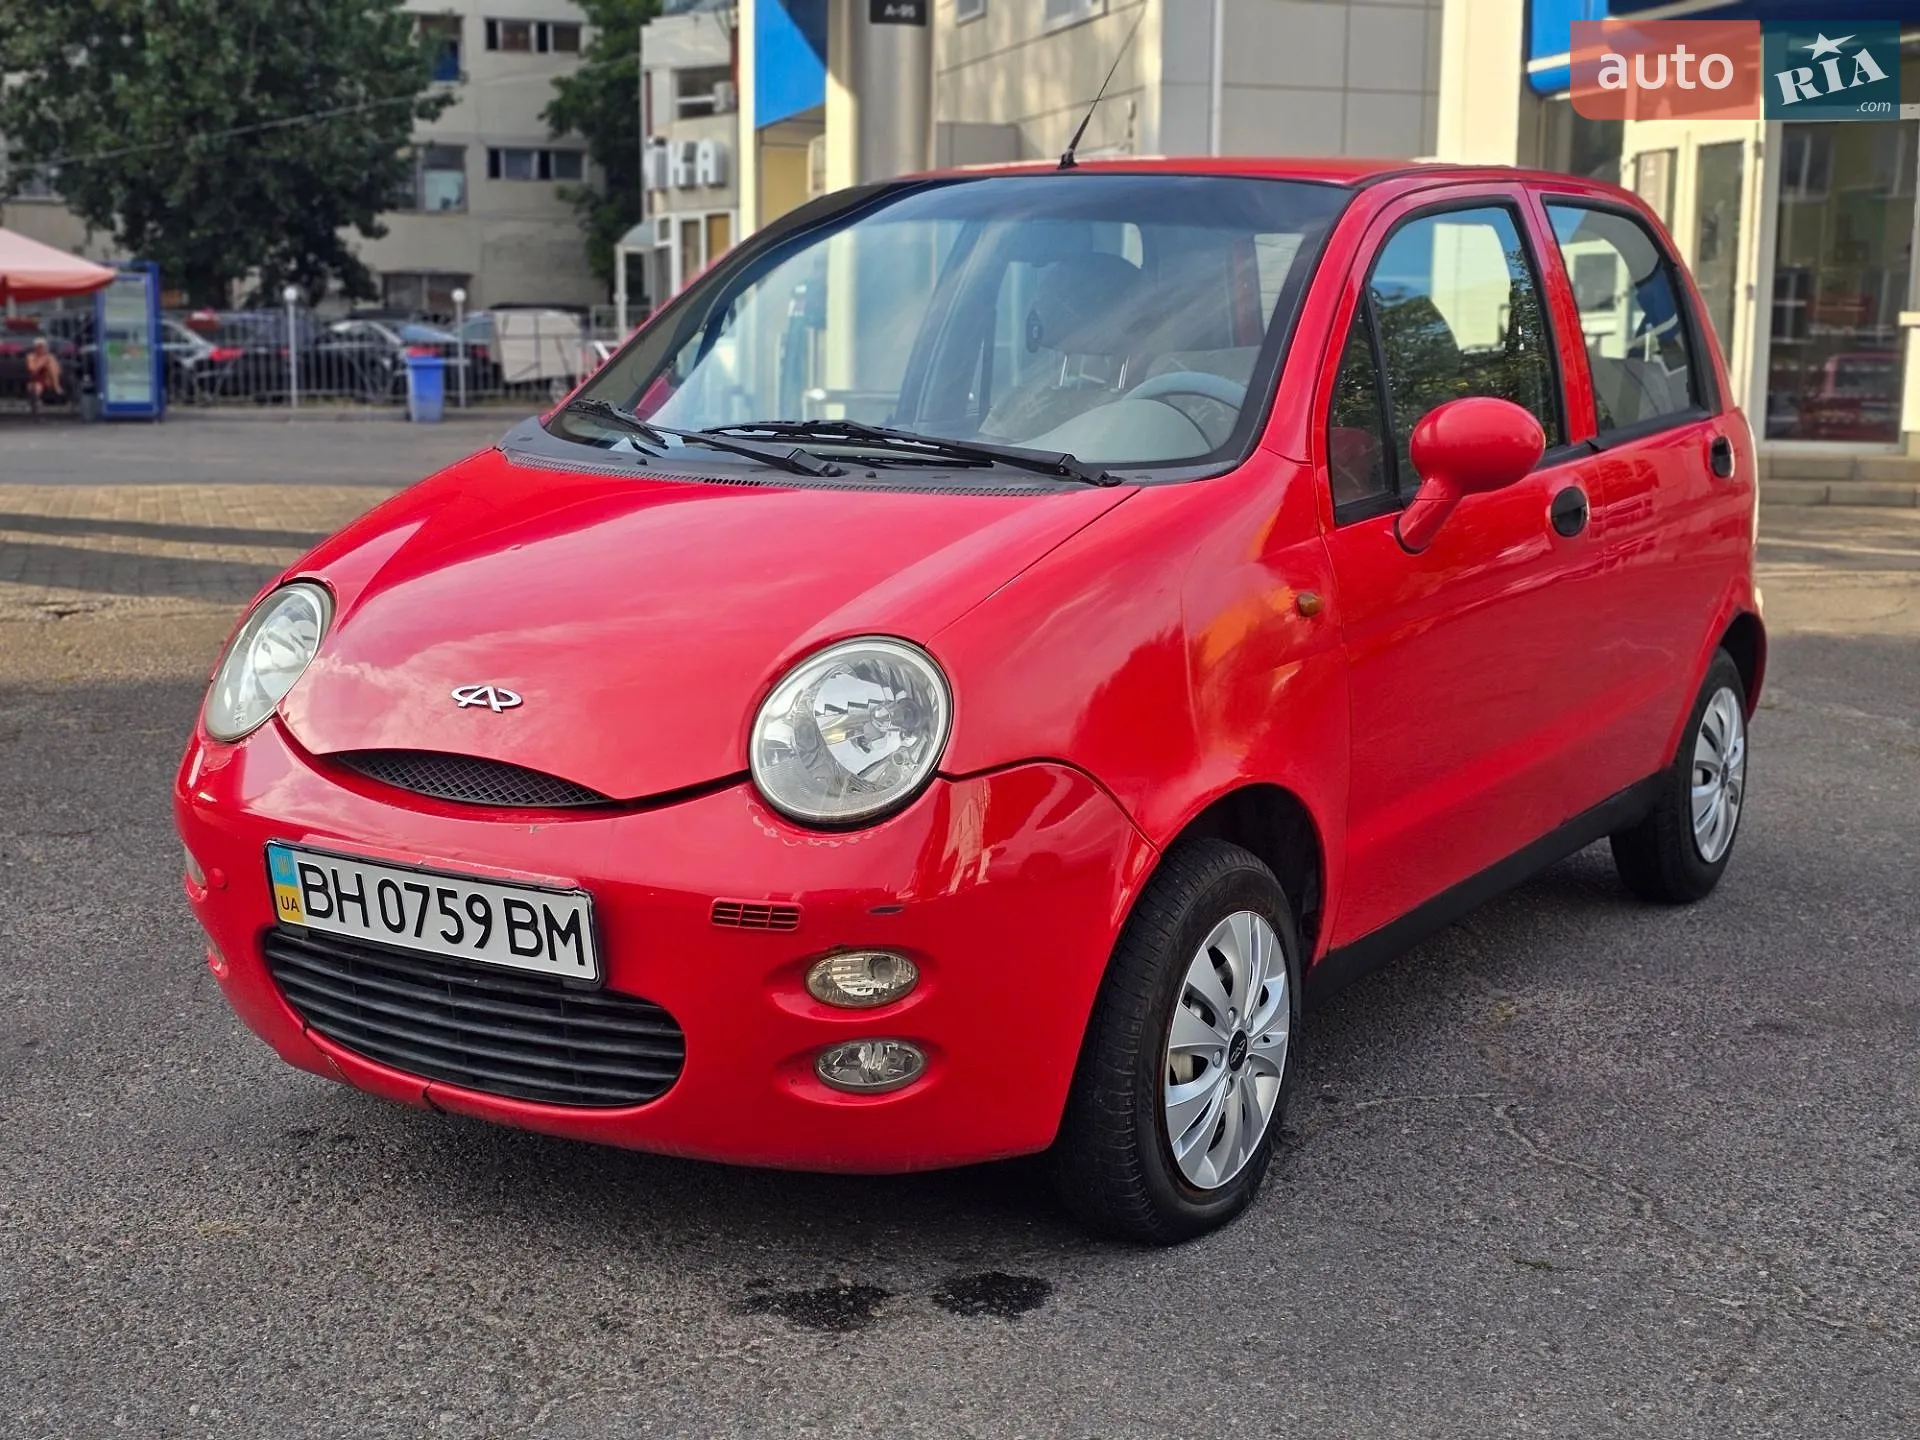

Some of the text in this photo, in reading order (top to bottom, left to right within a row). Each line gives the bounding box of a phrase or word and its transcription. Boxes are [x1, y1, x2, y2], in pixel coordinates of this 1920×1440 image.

[280, 895, 300, 913] UA
[297, 861, 586, 966] BH 0759 BM
